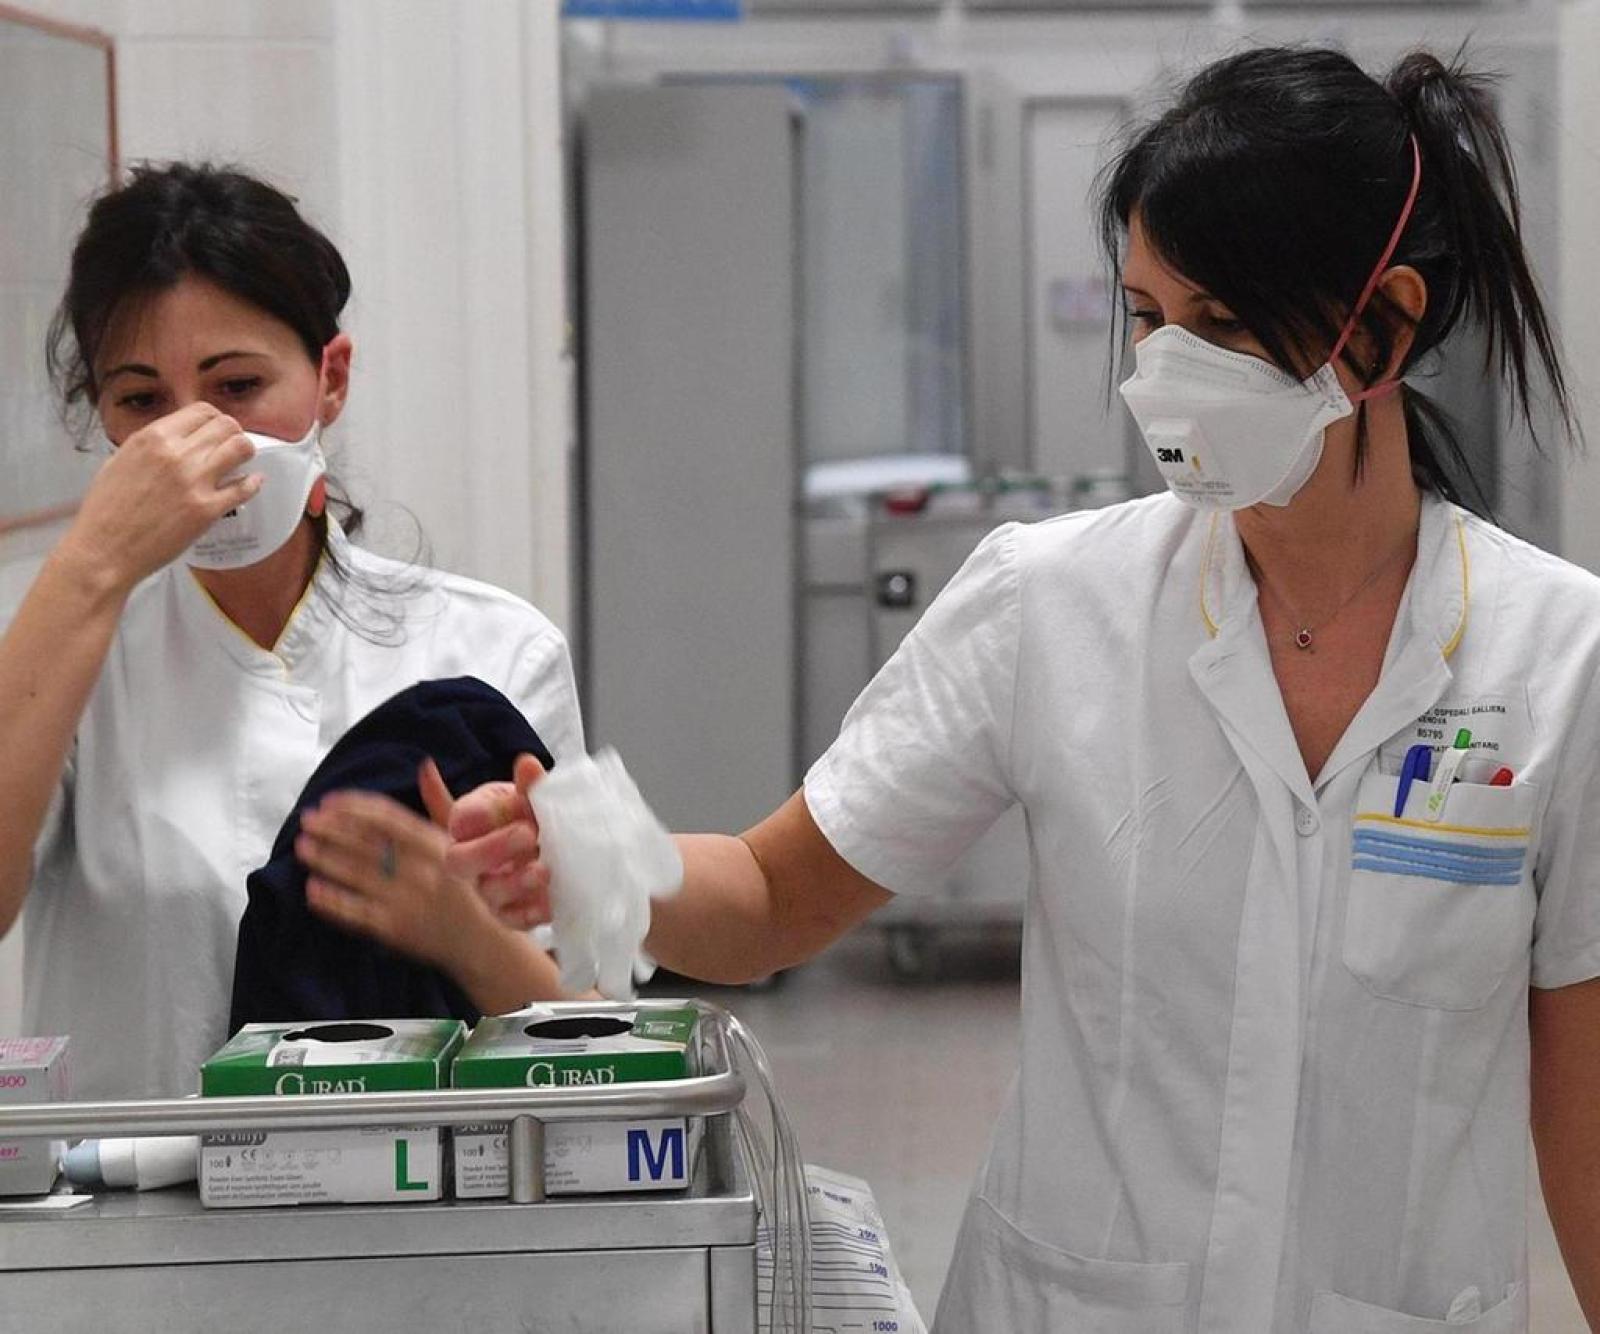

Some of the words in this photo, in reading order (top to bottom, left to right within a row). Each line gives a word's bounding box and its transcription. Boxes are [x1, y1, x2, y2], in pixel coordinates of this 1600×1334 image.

[1157, 447, 1184, 463] 3M
[526, 1061, 615, 1088] CURAD
[396, 1139, 428, 1191] L
[627, 1128, 683, 1181] M
[872, 1320, 898, 1332] 1000
